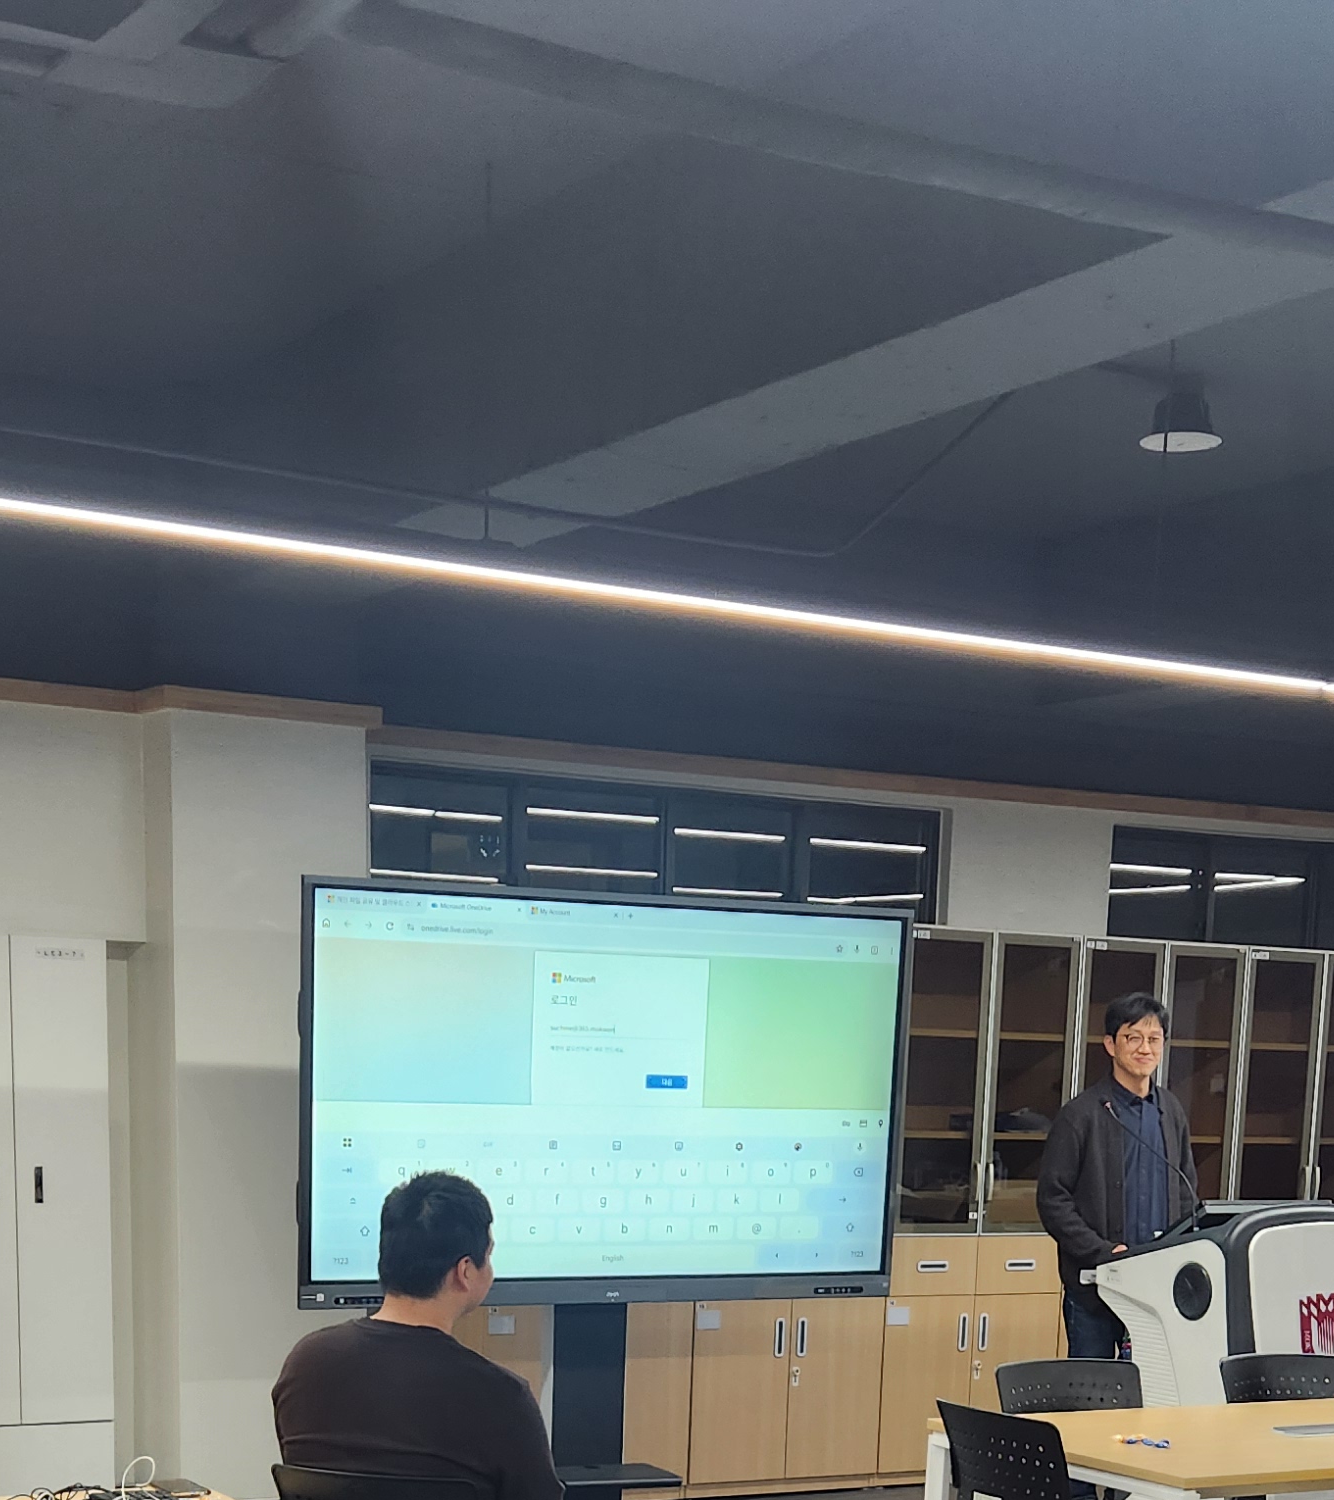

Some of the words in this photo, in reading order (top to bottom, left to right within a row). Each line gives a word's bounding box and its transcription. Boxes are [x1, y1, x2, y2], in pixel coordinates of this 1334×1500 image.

[440, 903, 466, 911] Microsoft
[466, 904, 492, 912] OneDrive
[540, 908, 548, 917] My
[421, 924, 494, 936] onedrive.live.com/login
[563, 974, 597, 984] Microsoft
[550, 995, 578, 1007] 로그인
[397, 1166, 406, 1178] q
[494, 1167, 503, 1176] e
[543, 1166, 550, 1176] r
[591, 1165, 596, 1177] t
[635, 1167, 642, 1179] y
[680, 1167, 687, 1177] u
[767, 1167, 775, 1177] o
[809, 1167, 817, 1179] p
[506, 1194, 514, 1206] d
[554, 1194, 560, 1206] f
[599, 1196, 607, 1208] g
[645, 1194, 652, 1205] h
[691, 1194, 696, 1208] j
[733, 1194, 740, 1205] k
[529, 1225, 537, 1235] c
[575, 1225, 583, 1235] v
[621, 1222, 628, 1234] b
[666, 1224, 673, 1233] n
[708, 1224, 719, 1233] m
[751, 1222, 762, 1235] @
[601, 1254, 625, 1264] English
